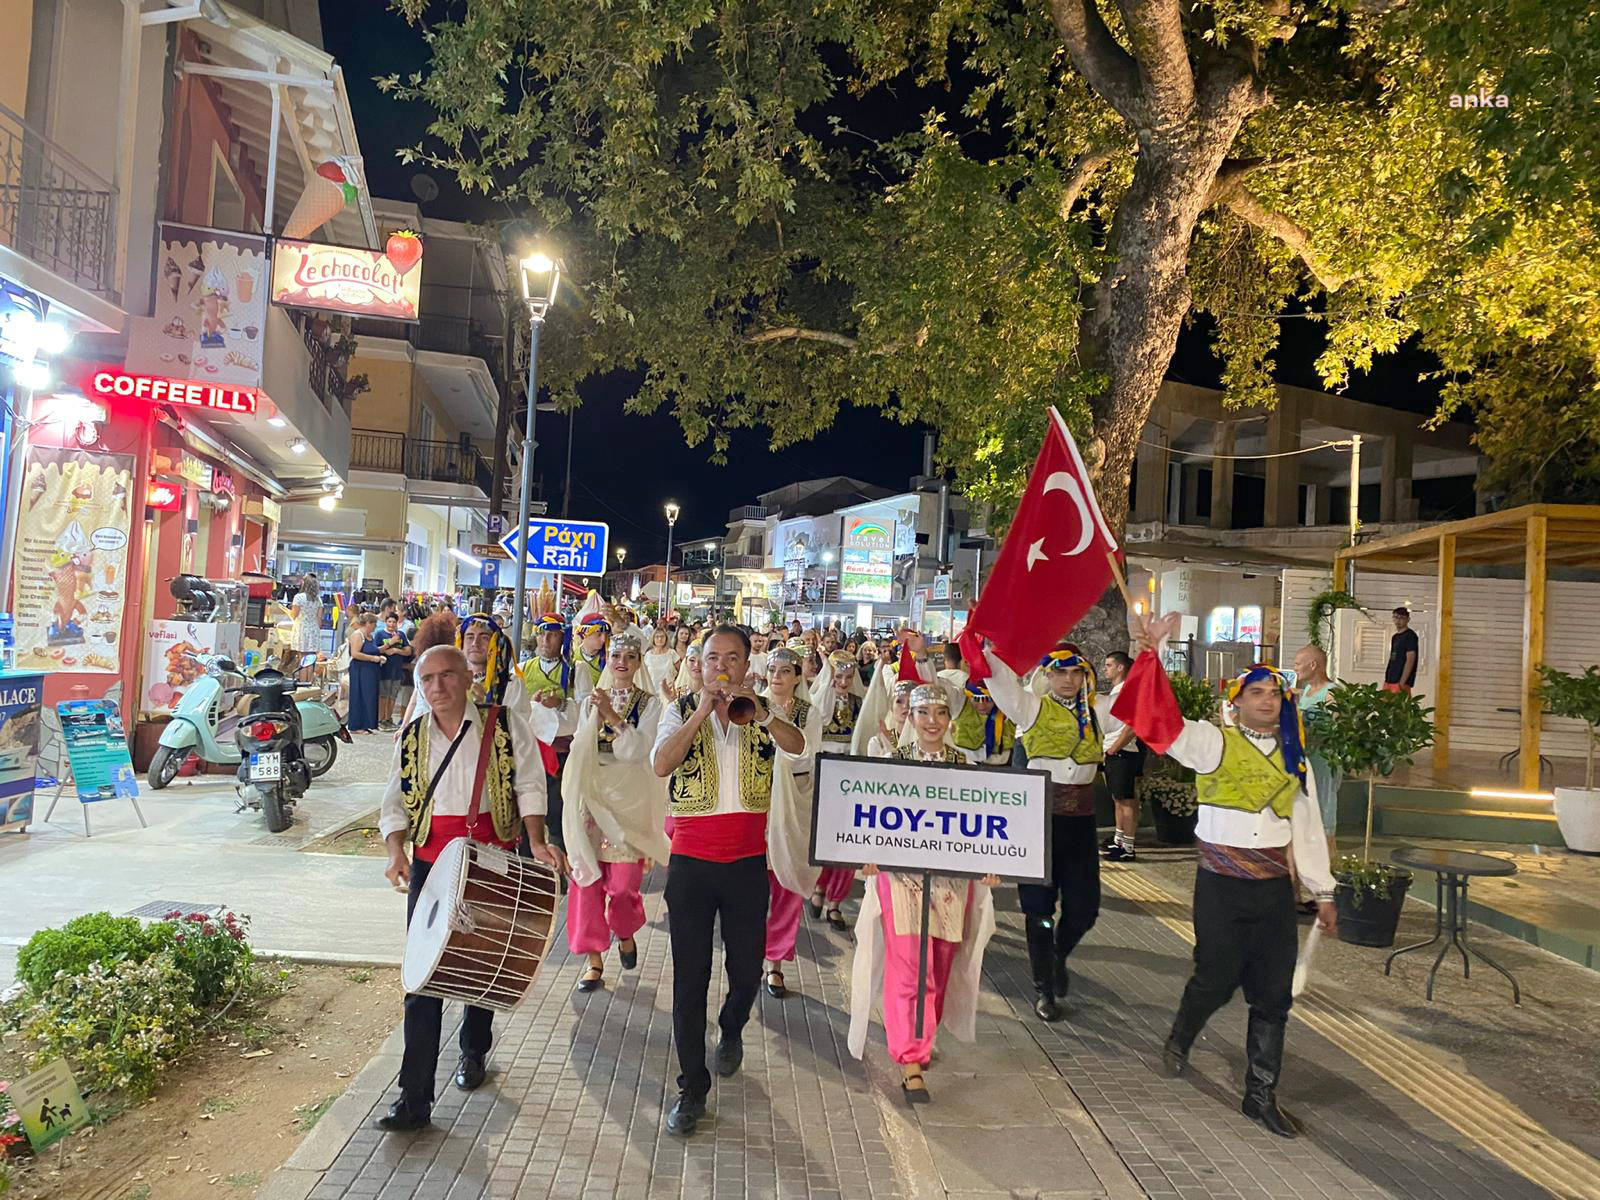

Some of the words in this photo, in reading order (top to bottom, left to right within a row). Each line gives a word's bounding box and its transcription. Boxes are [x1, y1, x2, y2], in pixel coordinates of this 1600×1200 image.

[94, 372, 202, 405] COFFEE
[544, 525, 596, 550] Ράχη
[485, 562, 495, 576] P
[543, 549, 588, 568] Rahi
[0, 687, 36, 706] LACE
[258, 766, 279, 776] 588
[839, 778, 921, 798] ÇANKAYA
[925, 785, 1028, 807] BELEDİYESİ
[853, 803, 1009, 841] HOY-TUR
[836, 832, 871, 845] HALK
[875, 835, 942, 851] DANSLARI
[946, 841, 1027, 858] TOPLULUĞU
